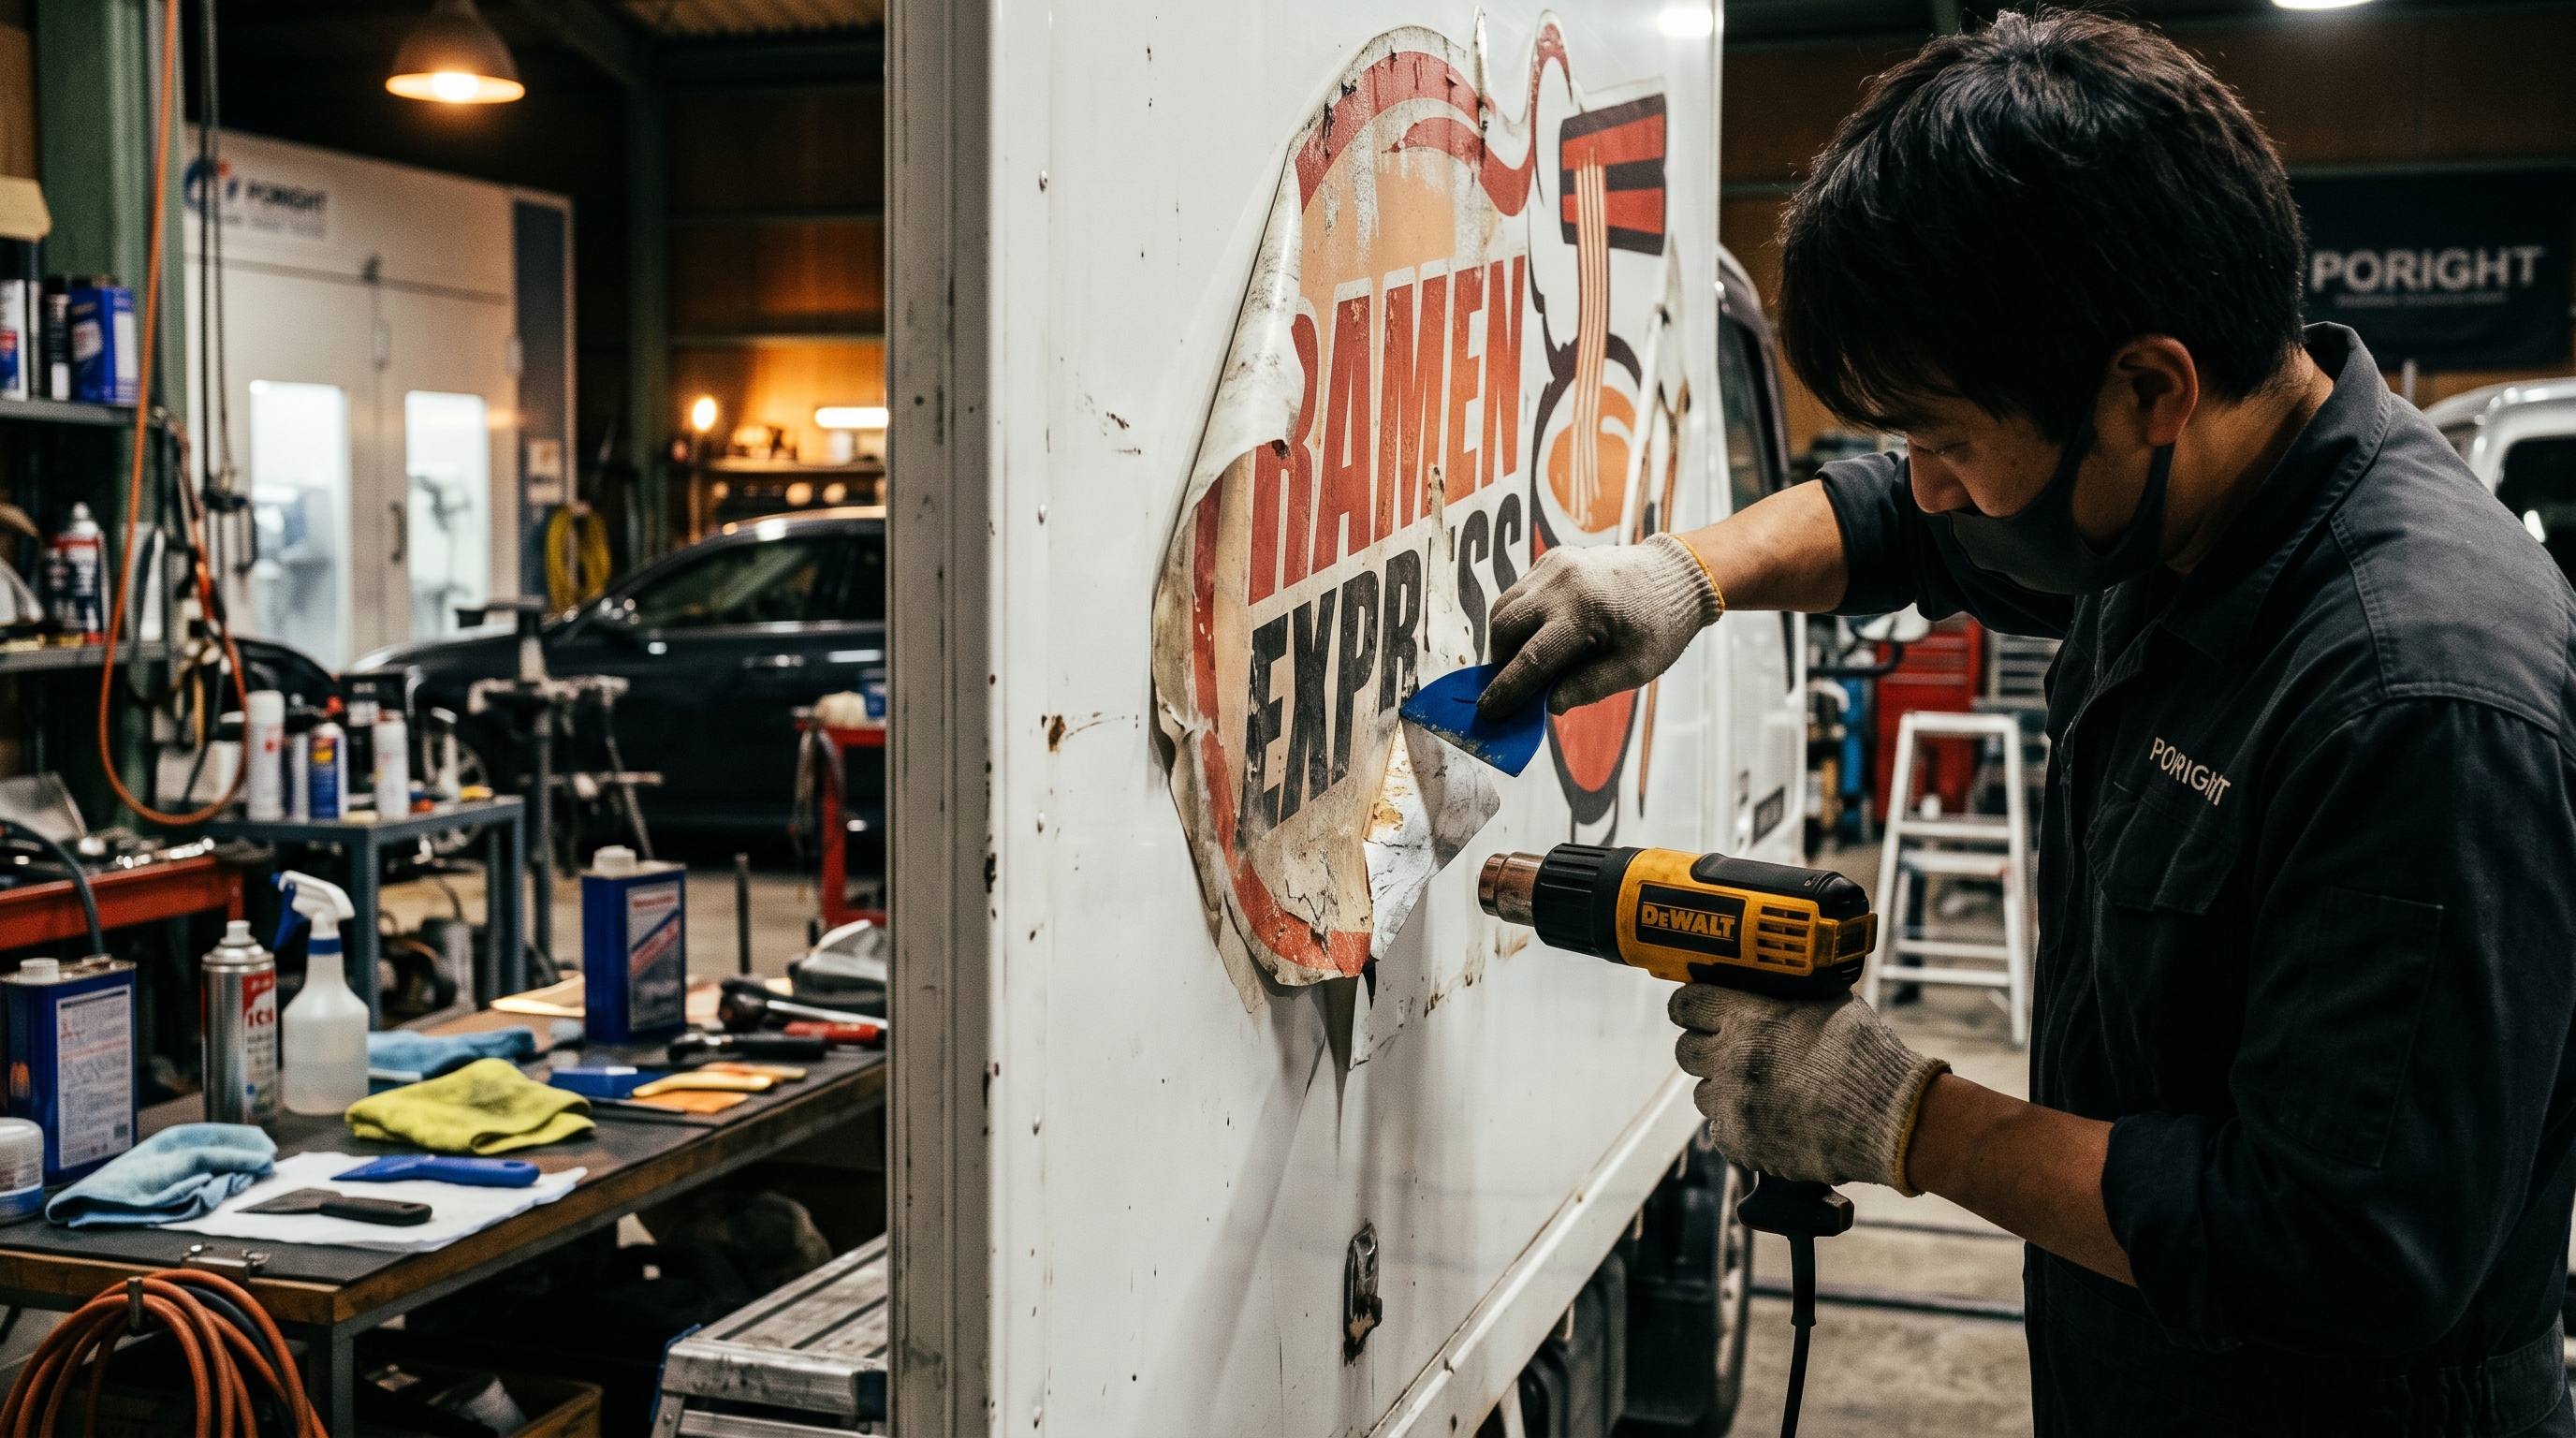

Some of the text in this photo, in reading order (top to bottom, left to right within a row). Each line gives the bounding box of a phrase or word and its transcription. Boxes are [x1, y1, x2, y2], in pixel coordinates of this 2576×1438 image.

[2309, 244, 2544, 293] PORIGHT
[1248, 255, 1525, 607] RAMEN
[1238, 492, 1522, 835] EXPRSS
[2149, 737, 2232, 806] PORIGHT
[1641, 903, 1735, 938] DEWALT
